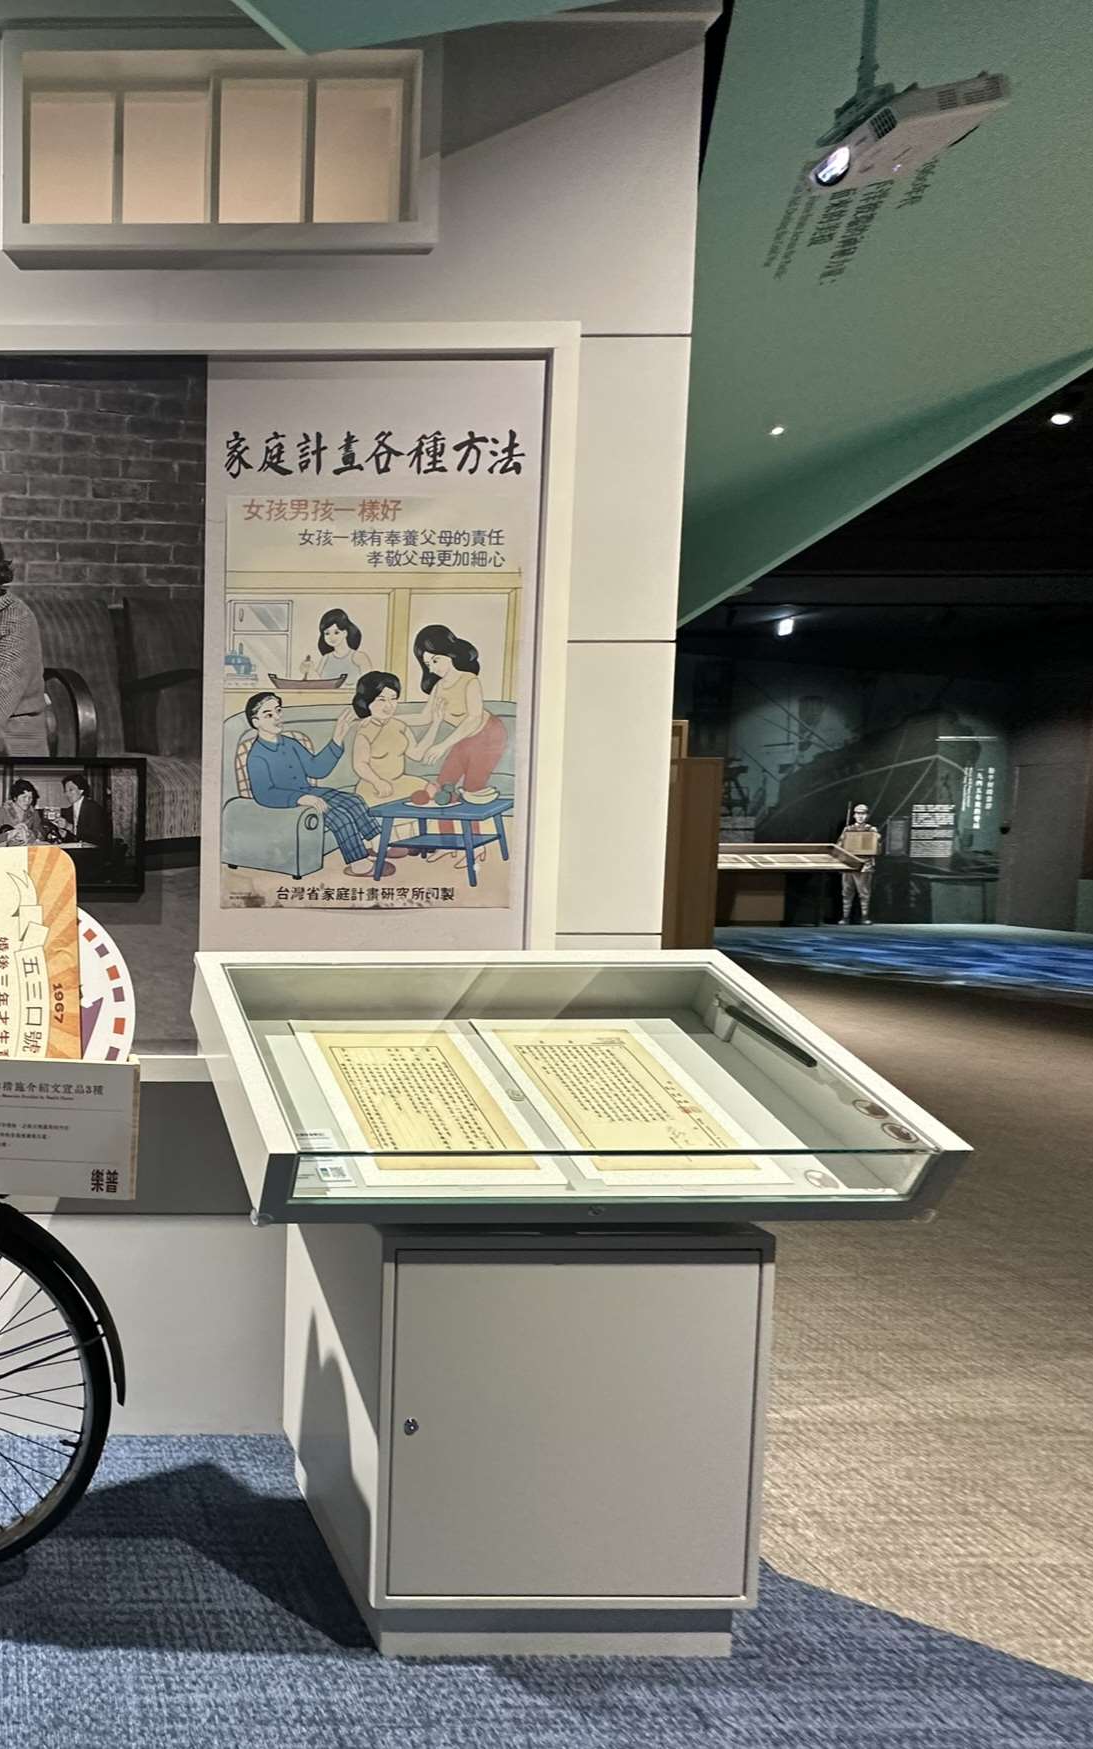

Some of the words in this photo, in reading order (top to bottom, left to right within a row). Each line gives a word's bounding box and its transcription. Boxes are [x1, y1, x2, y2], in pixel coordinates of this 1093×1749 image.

[243, 499, 403, 522] 女孩男孩一樣好
[298, 529, 505, 547] 女孩一樣有奉養父母的責任
[366, 550, 506, 568] 孝敬父母更加細心
[21, 956, 43, 1054] 五三口號
[52, 983, 65, 1024] 1967
[90, 1169, 119, 1193] 樂普
